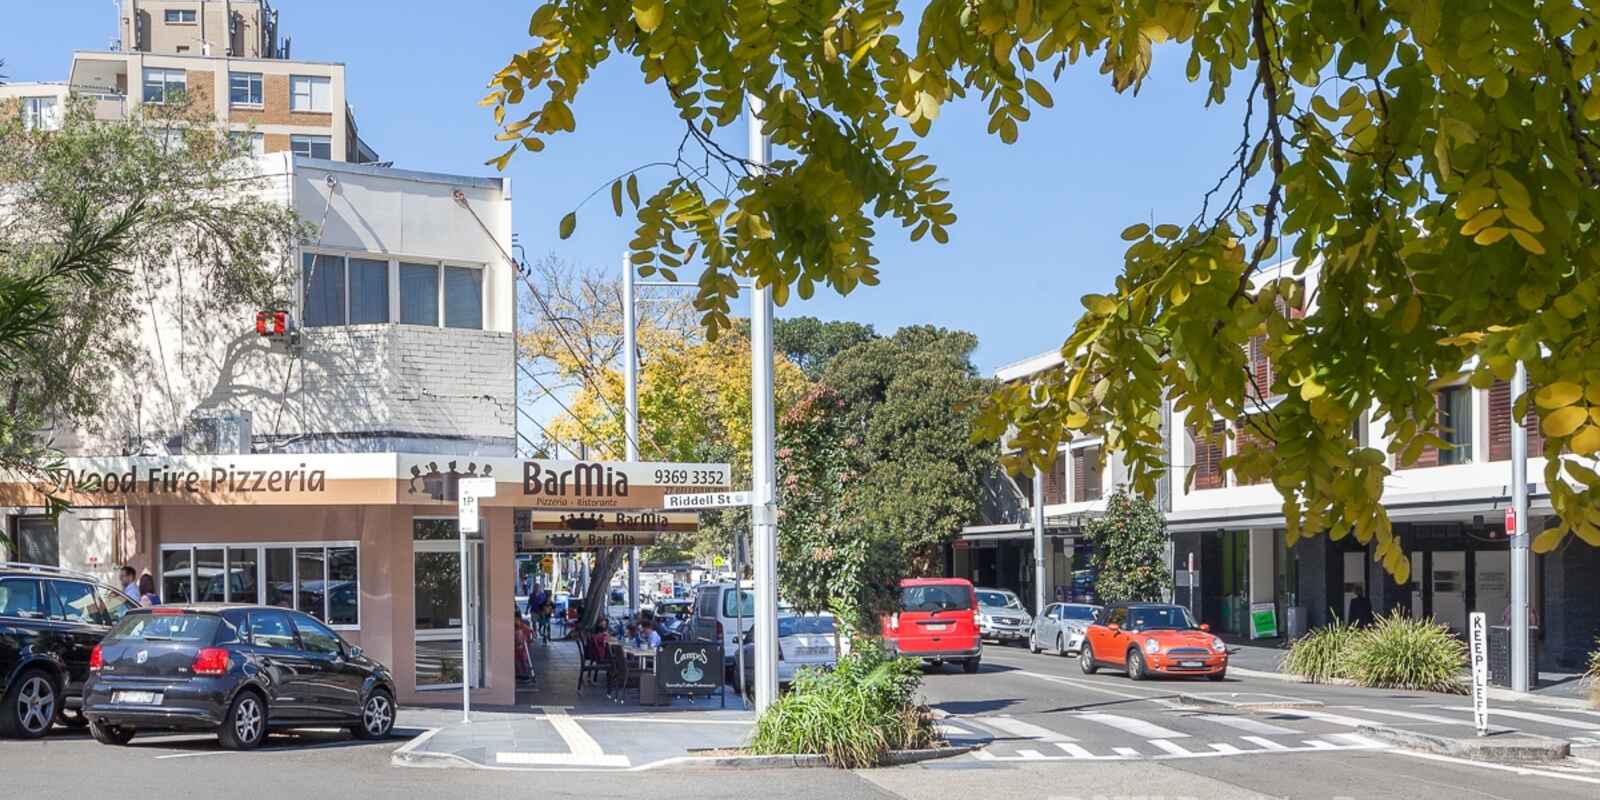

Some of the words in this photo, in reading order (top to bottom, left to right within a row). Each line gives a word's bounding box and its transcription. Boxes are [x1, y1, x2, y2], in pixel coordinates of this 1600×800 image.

[57, 465, 137, 494] Wood
[149, 464, 199, 493] Fire
[211, 463, 326, 493] Pizzeria
[655, 469, 688, 484] 9369
[692, 470, 724, 485] 3352
[536, 497, 568, 506] Pizzeria
[670, 495, 713, 507] Riddell
[718, 494, 731, 505] St
[588, 534, 607, 545] Bar
[612, 533, 635, 545] Mia
[1473, 615, 1484, 666] KEEP
[1476, 675, 1485, 727] LEFT
